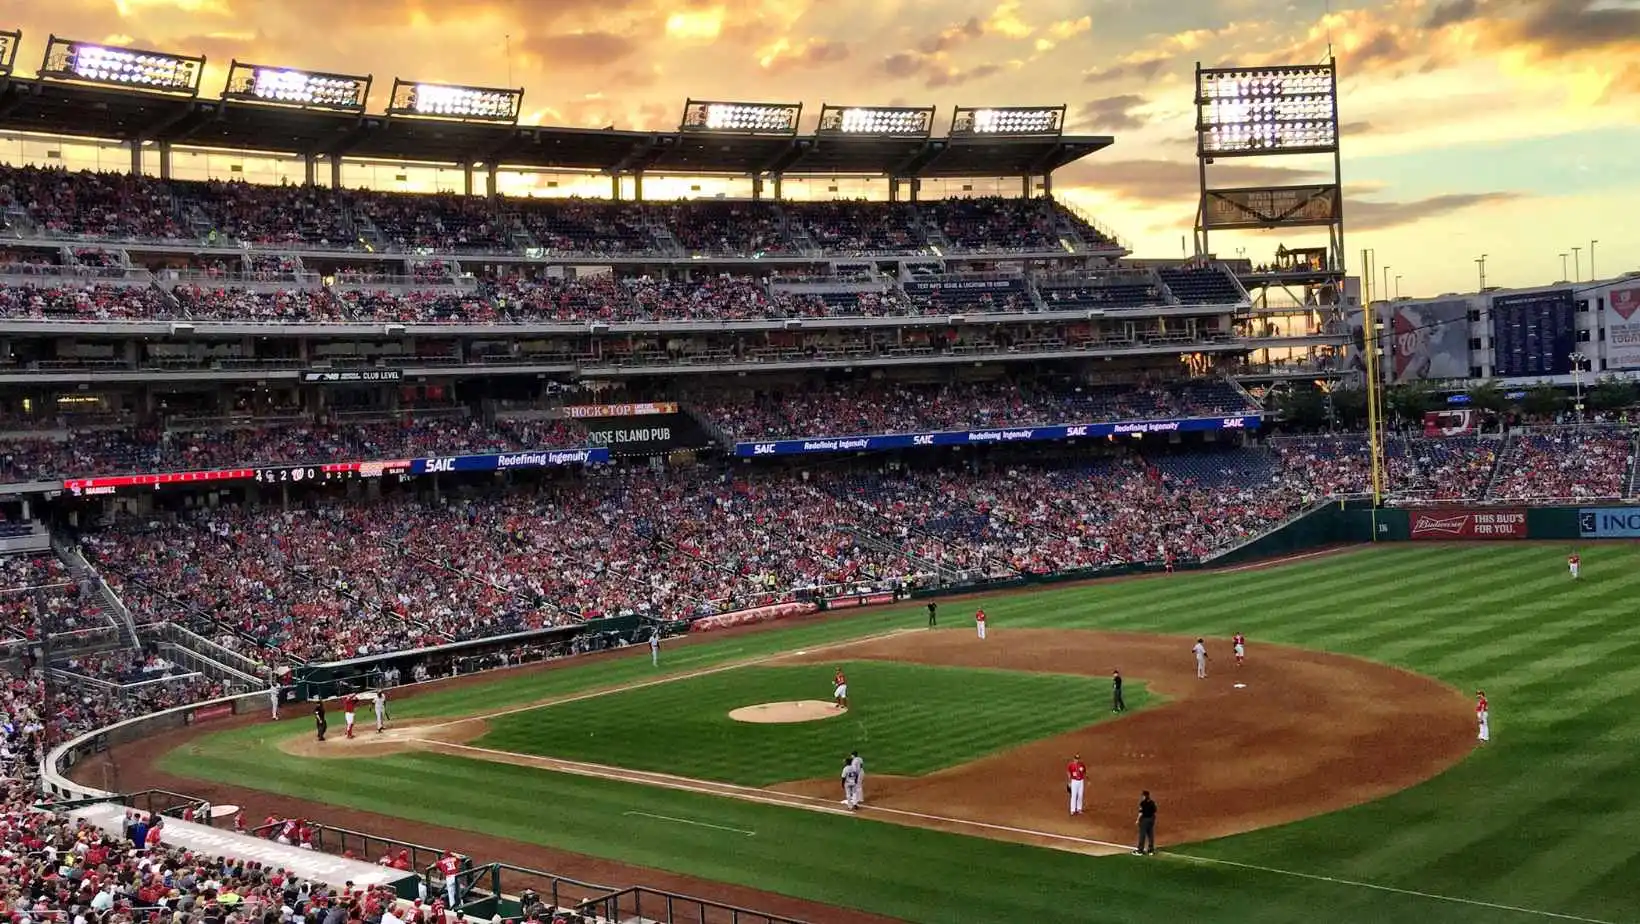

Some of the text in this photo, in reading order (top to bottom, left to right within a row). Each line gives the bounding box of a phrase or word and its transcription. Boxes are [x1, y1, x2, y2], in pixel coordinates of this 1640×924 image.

[362, 371, 379, 380] CLUB
[380, 371, 400, 379] LEVEL
[563, 405, 602, 418] SHOCK
[608, 403, 631, 416] TOP
[1114, 421, 1179, 434] Redefining Ingenuity
[1223, 418, 1244, 428] SAIC
[615, 428, 650, 443] ISLAND
[651, 427, 671, 441] PUB
[968, 429, 1034, 441] Redefining Ingenuity
[1067, 426, 1087, 436] SAIC
[803, 438, 869, 451] Redefining Ingenuity
[913, 434, 934, 445] SAIC
[753, 444, 776, 454] SAIC
[498, 450, 589, 468] Redefining Ingenuity
[425, 458, 456, 473] SAIC
[280, 470, 287, 481] 2
[307, 468, 315, 479] 0
[1474, 513, 1525, 524] THIS BUD'S
[1474, 524, 1516, 534] FOR YOU.
